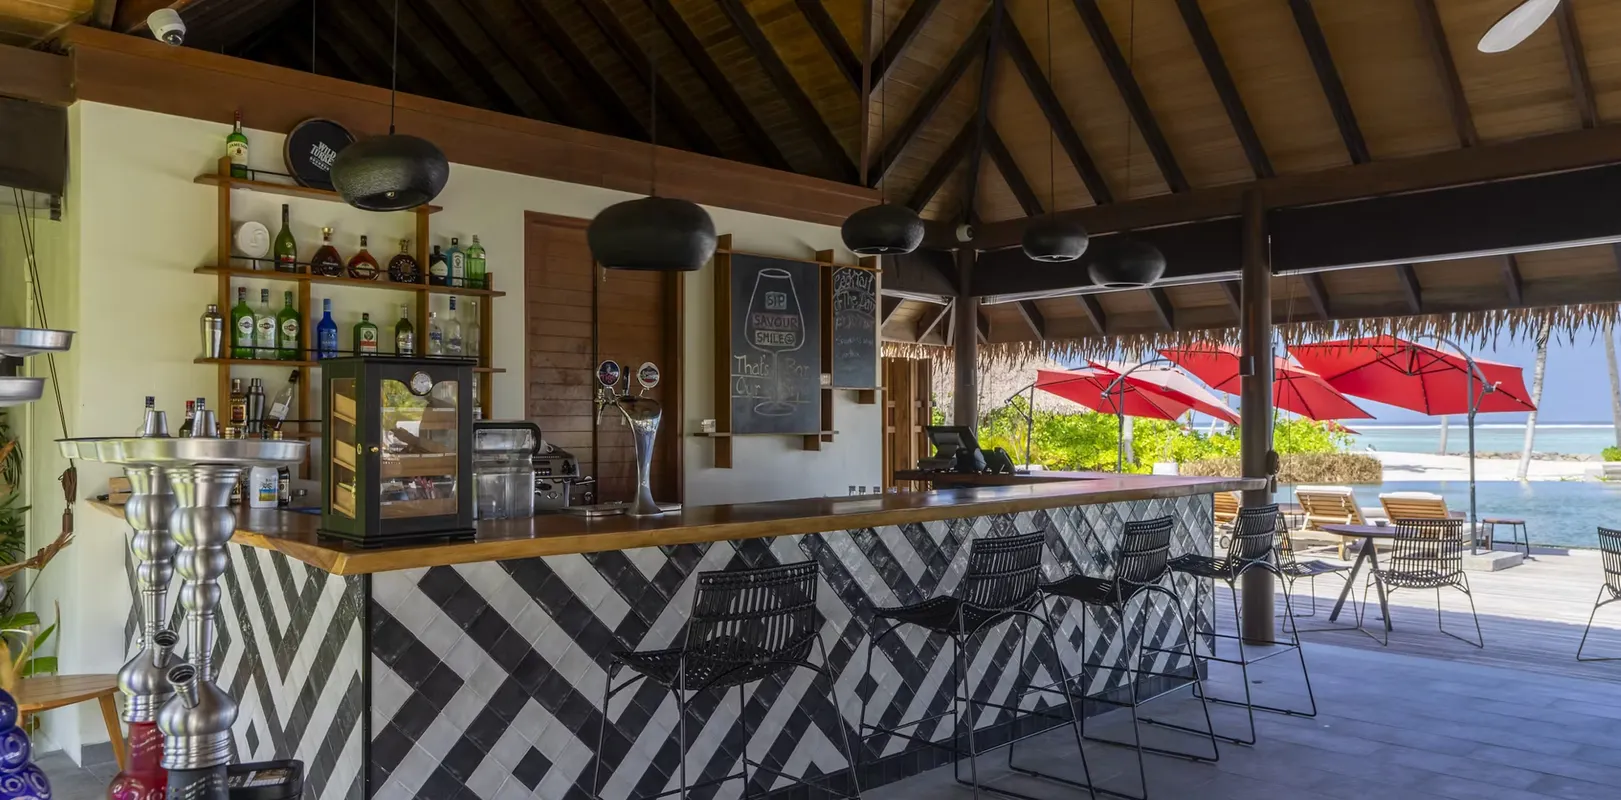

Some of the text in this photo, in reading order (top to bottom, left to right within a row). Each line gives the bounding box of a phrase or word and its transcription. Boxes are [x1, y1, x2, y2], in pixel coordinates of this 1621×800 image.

[310, 143, 335, 166] TURKE
[318, 141, 337, 159] WILD
[767, 295, 785, 307] SIP
[753, 314, 798, 329] SAVOUR
[757, 332, 784, 344] SMILE
[734, 354, 769, 376] That's
[735, 376, 761, 396] Our
